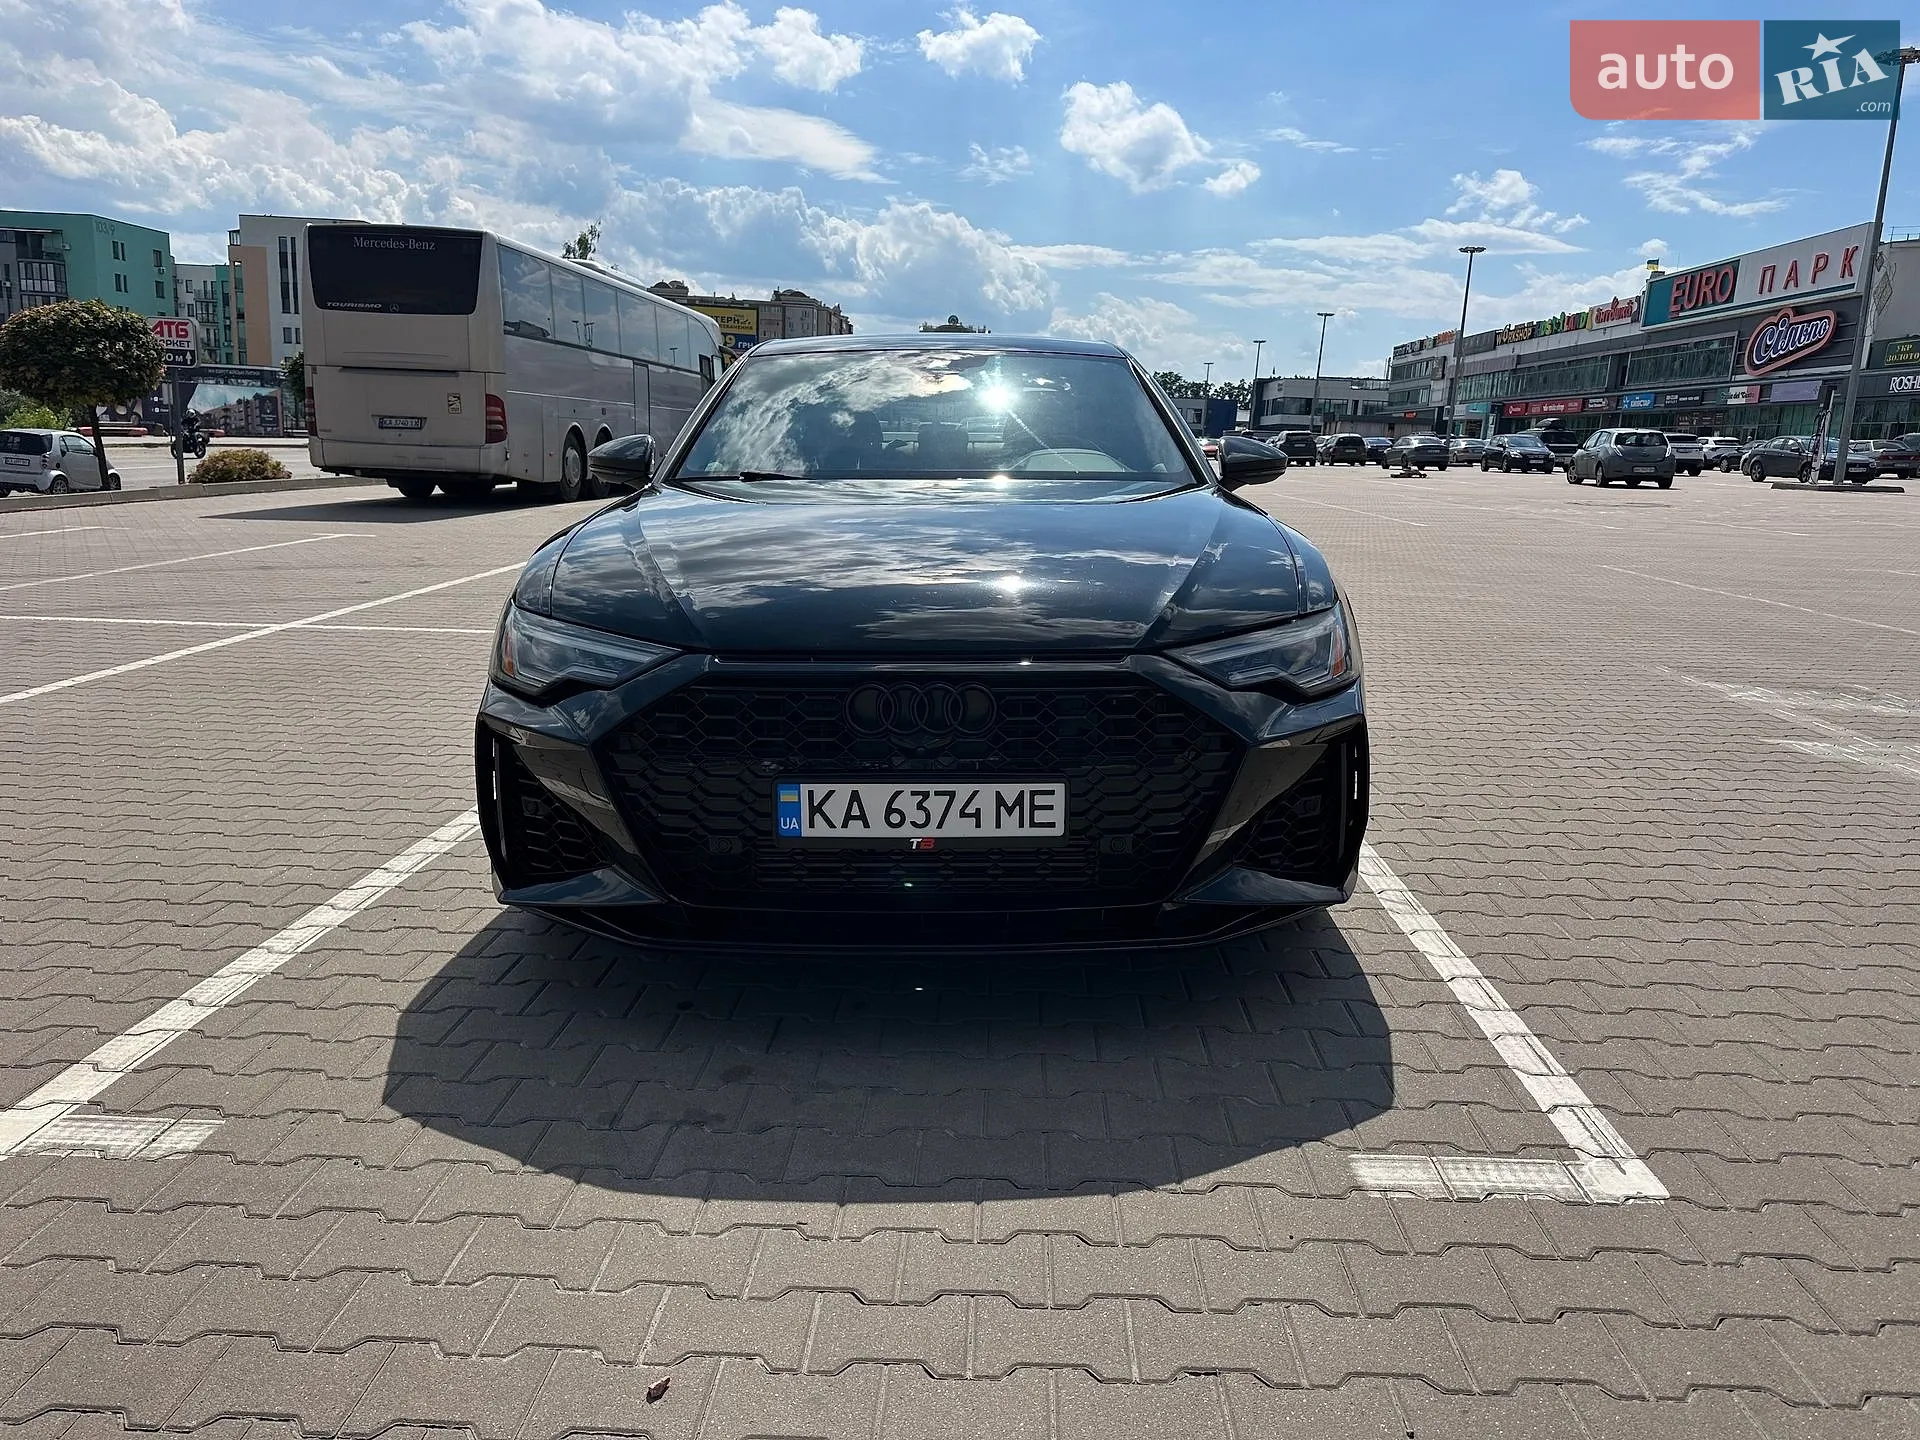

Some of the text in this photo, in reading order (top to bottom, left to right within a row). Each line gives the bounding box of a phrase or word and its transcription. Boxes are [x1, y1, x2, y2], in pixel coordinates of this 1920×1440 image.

[353, 236, 436, 250] Mercedes-Benz
[1670, 245, 1859, 313] EURO ПАРК
[327, 301, 382, 309] TOURISMO
[151, 320, 190, 338] АТБ
[1753, 317, 1829, 365] Сільпо
[807, 789, 1057, 829] KA 6374 ME
[780, 817, 799, 830] UA
